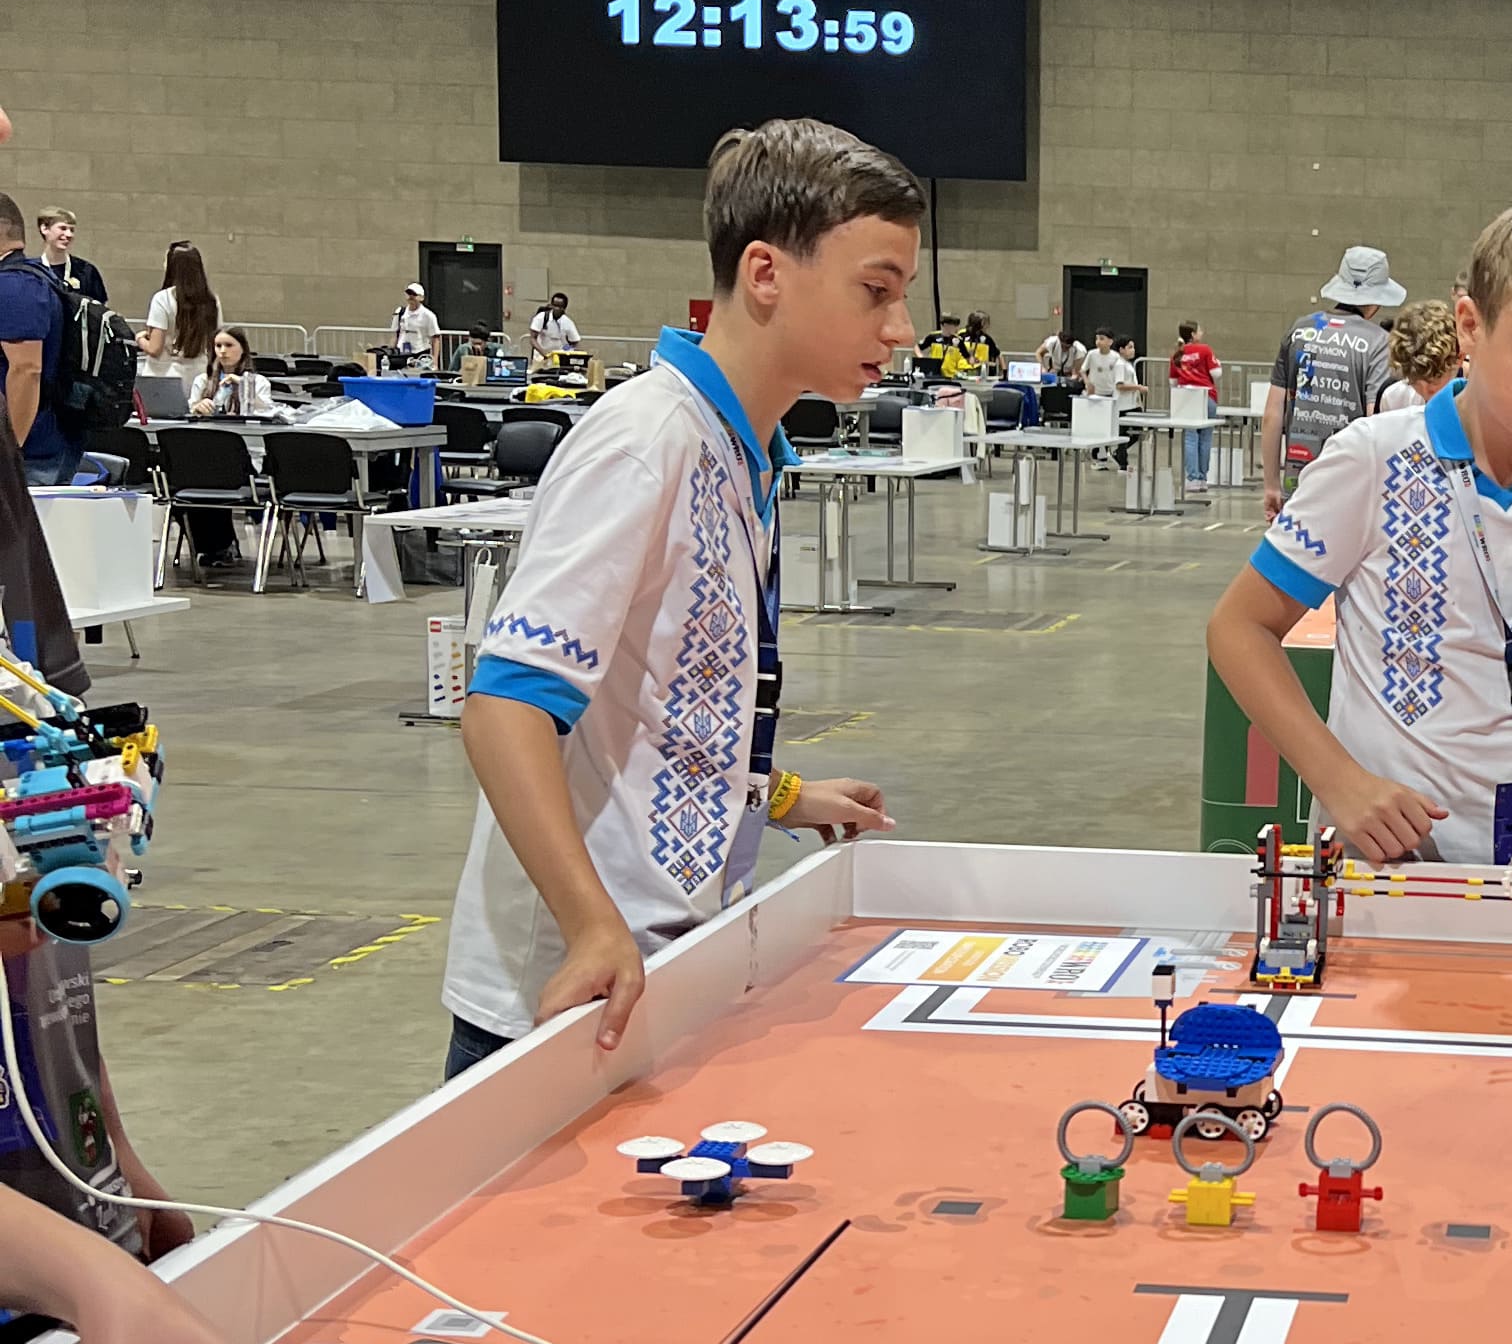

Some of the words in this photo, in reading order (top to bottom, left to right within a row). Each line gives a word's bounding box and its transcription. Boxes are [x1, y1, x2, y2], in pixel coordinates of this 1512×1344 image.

[1291, 327, 1369, 354] POLAND
[1303, 343, 1348, 358] SZYMON
[1310, 375, 1350, 393] ASTOR
